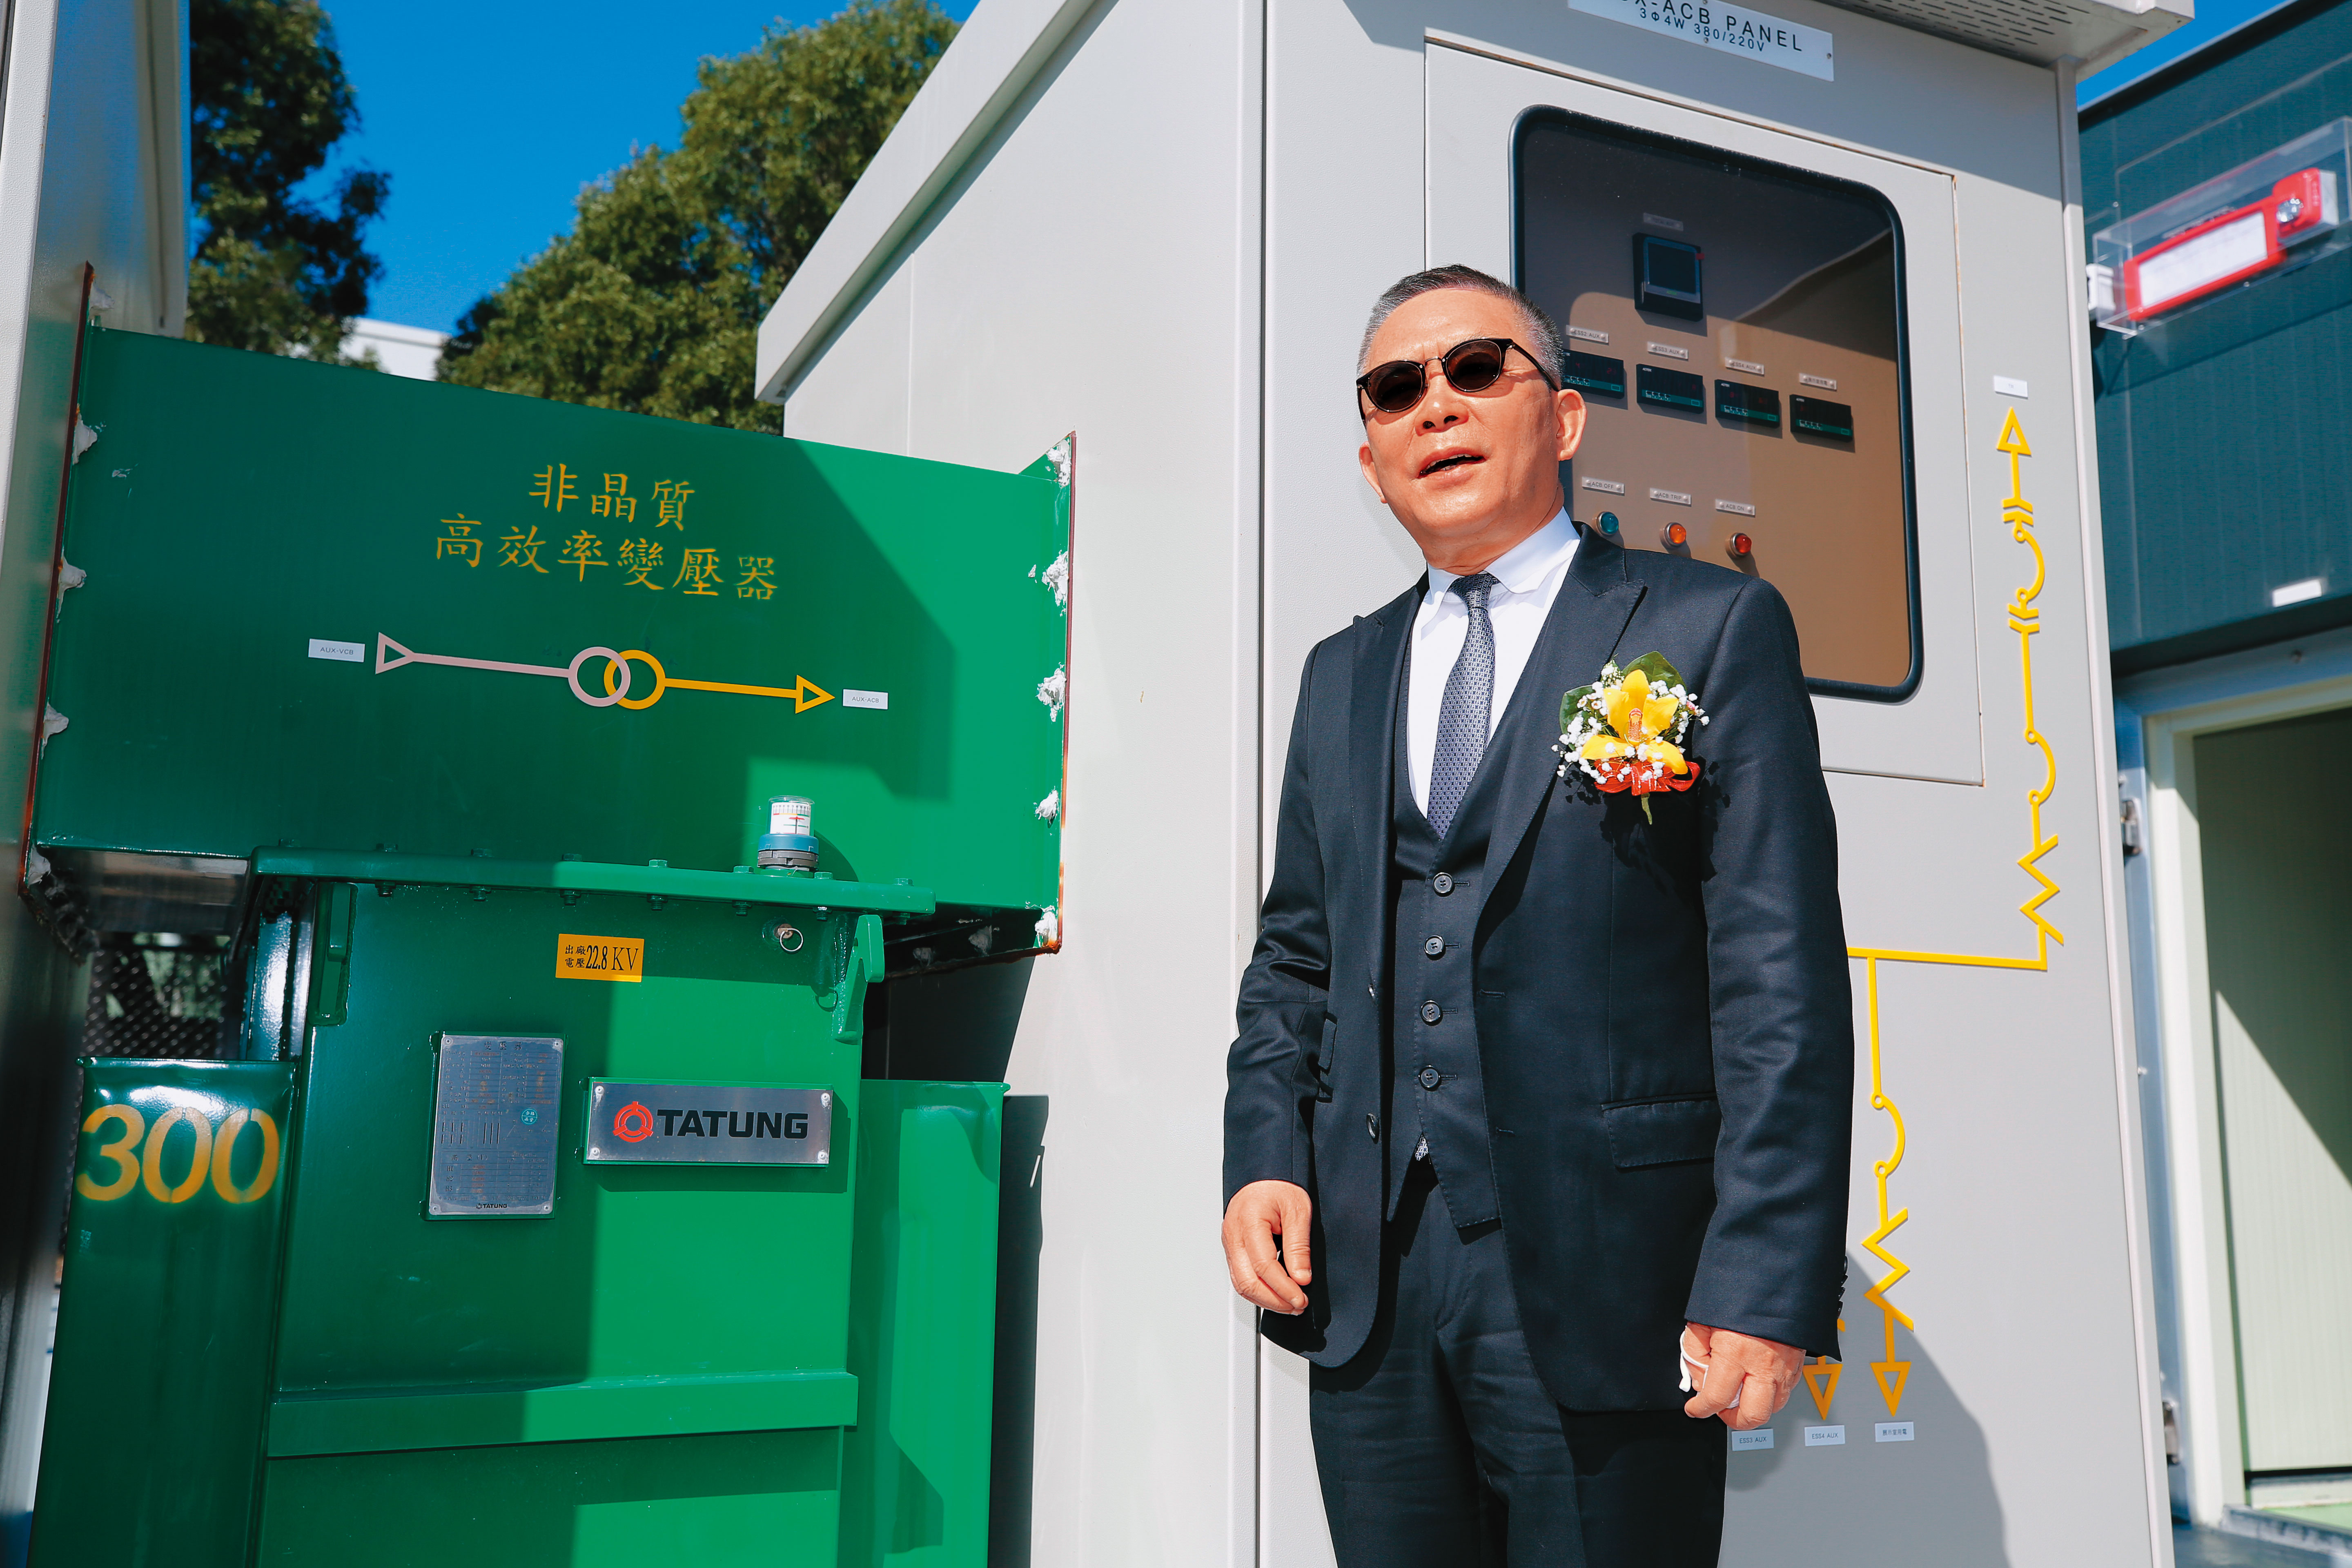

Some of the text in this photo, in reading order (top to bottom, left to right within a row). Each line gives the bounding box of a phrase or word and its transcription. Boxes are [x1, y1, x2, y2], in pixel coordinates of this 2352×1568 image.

[1694, 23, 1765, 51] 380/220V
[1726, 15, 1802, 51] PANEL
[528, 463, 695, 531] 非晶質
[436, 513, 778, 600] 高效率變壓器
[565, 944, 586, 955] 出廠
[565, 958, 586, 968] 電壓
[585, 945, 639, 971] 22.8 KV
[657, 1109, 808, 1139] TATUNG
[76, 1103, 281, 1204] 300
